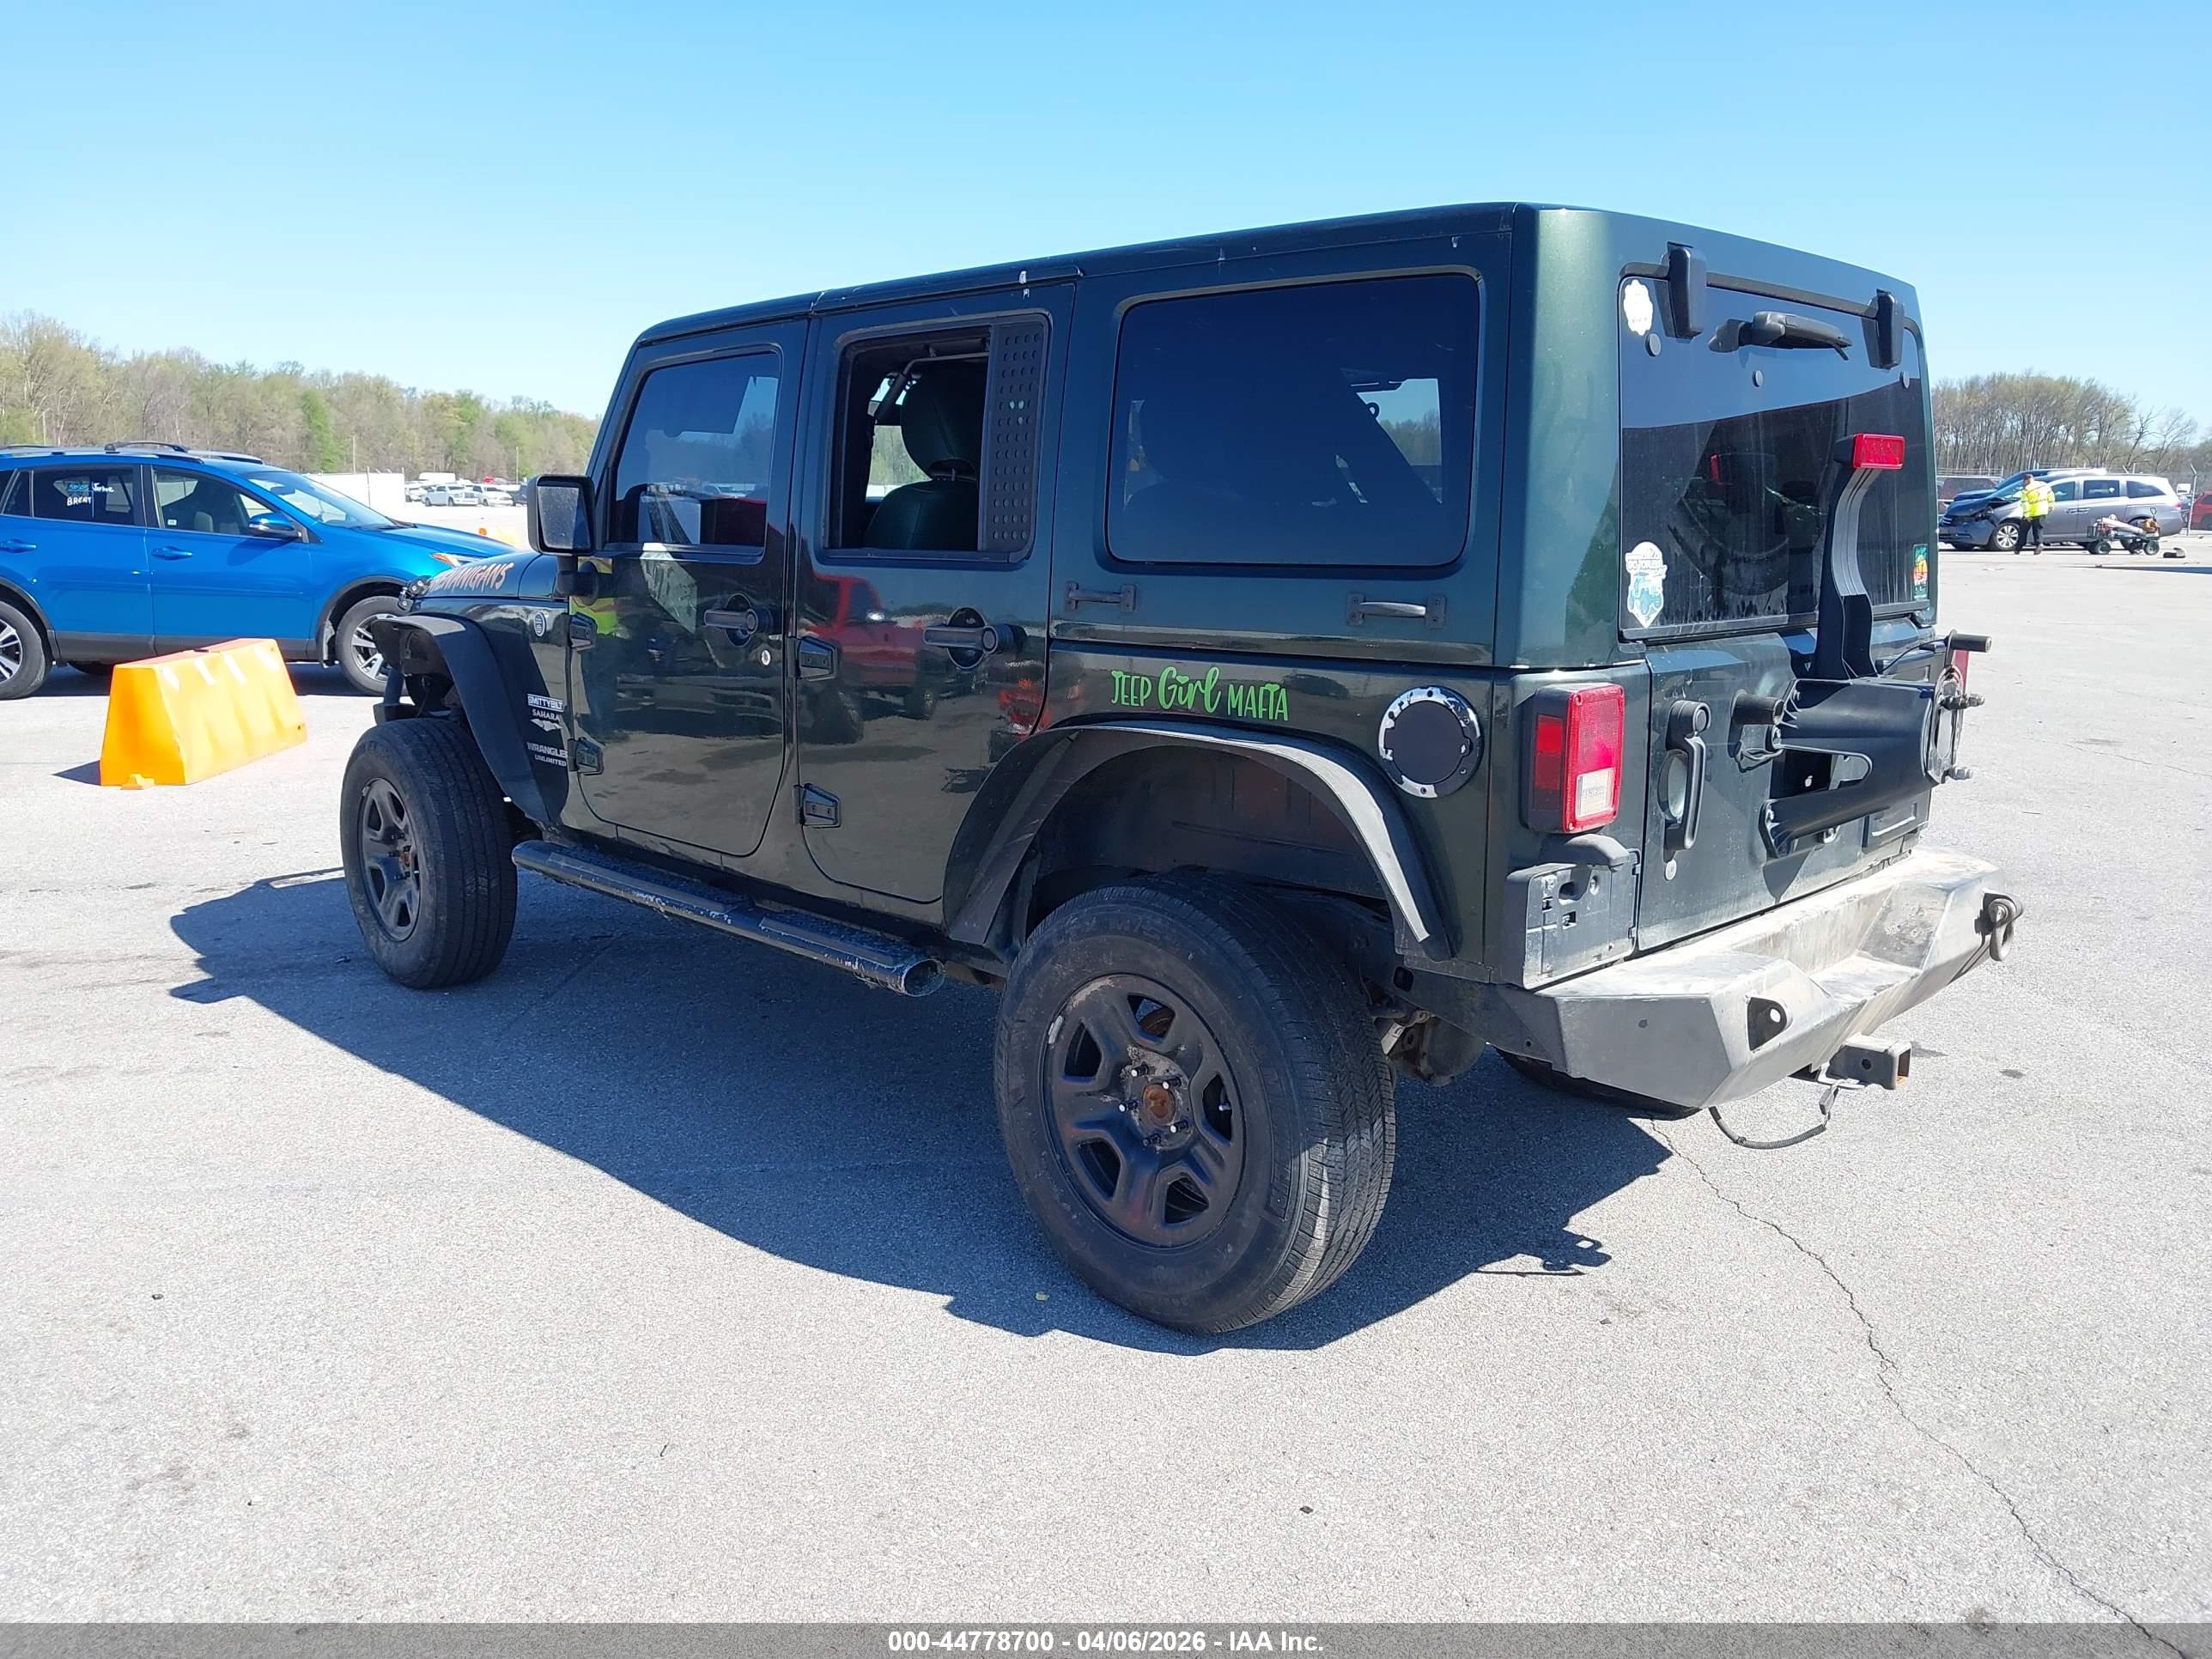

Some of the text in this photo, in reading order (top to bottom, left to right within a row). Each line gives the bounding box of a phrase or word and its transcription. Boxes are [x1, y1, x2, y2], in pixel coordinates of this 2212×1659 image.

[1111, 666, 1289, 721] JEEP Girl MAFIA
[527, 695, 563, 710] SMITTYBILT
[532, 708, 561, 721] SAHARA
[534, 754, 567, 767] UNLIMITED
